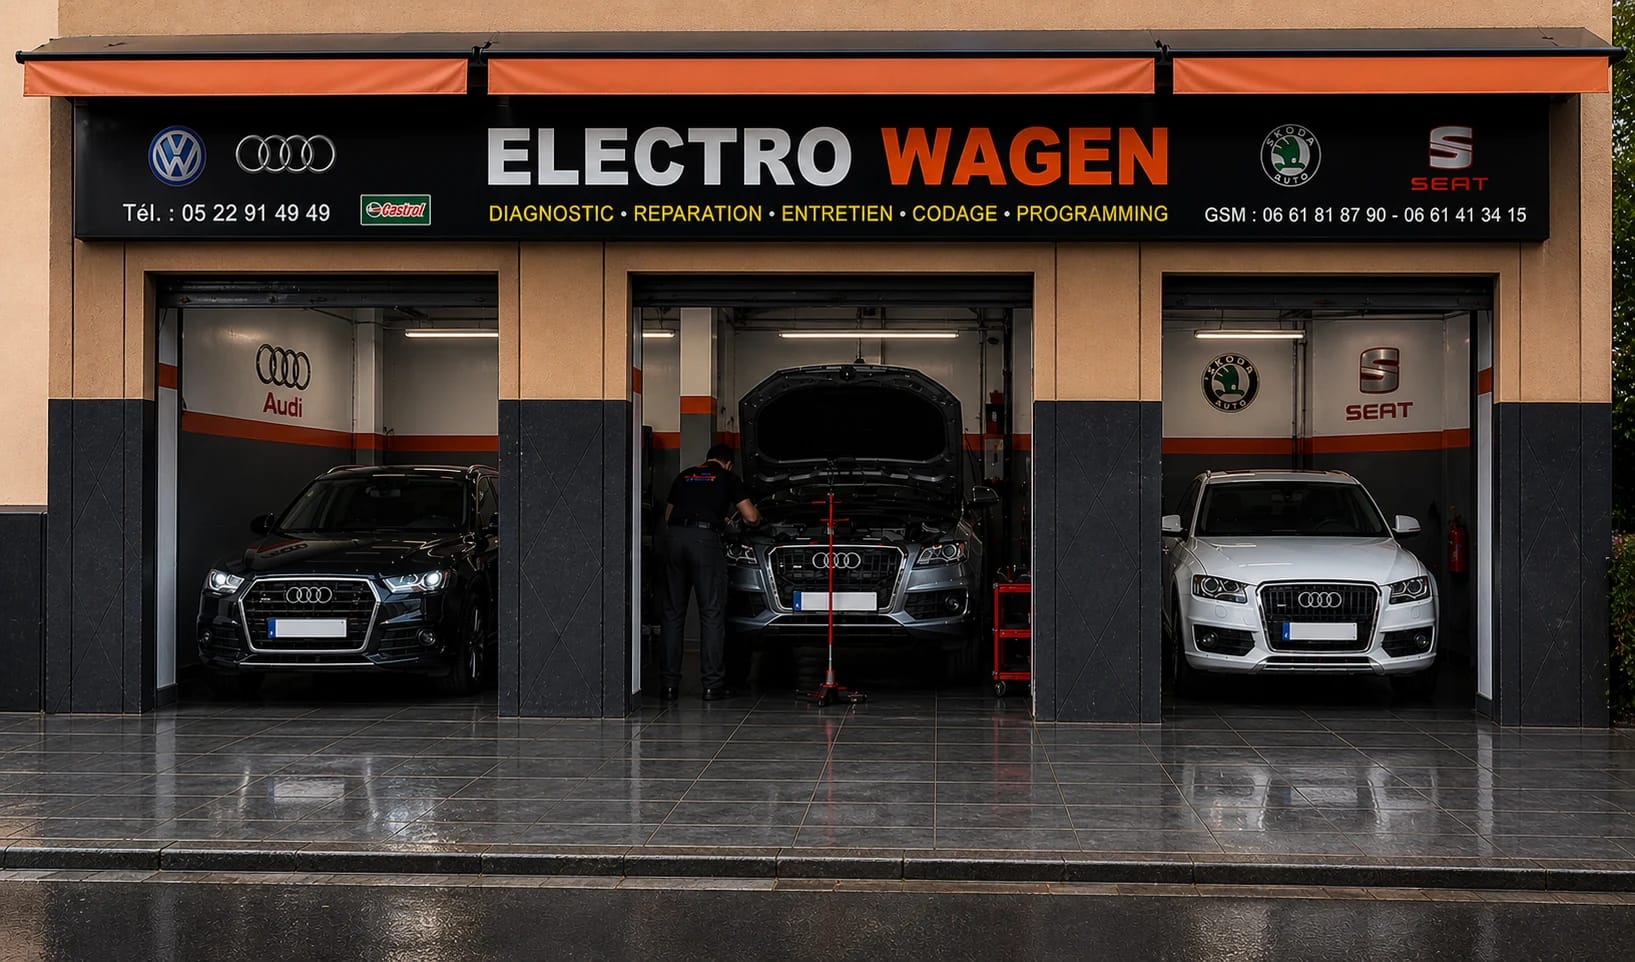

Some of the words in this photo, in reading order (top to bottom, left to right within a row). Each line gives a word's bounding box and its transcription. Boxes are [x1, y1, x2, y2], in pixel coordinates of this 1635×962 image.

[1266, 126, 1315, 148] SKODA
[488, 126, 852, 187] ELECTRO
[881, 127, 1169, 187] WAGEN
[1274, 173, 1308, 184] AUTO
[1411, 177, 1489, 191] SEAT
[123, 203, 161, 222] Tél.
[181, 203, 207, 222] 05
[212, 203, 238, 222] 22
[244, 203, 267, 222] 91
[274, 203, 299, 222] 49
[305, 203, 331, 222] 49
[382, 202, 427, 217] Castrol
[489, 205, 614, 222] DIAGNOSTIC
[634, 205, 762, 222] REPARATION
[782, 205, 893, 222] ENTRETIEN
[912, 205, 998, 222] CODAGE
[1017, 205, 1169, 222] PROGRAMMING
[1204, 206, 1246, 223] GSM
[1262, 206, 1284, 223] 06
[1288, 206, 1308, 223] 61
[1314, 206, 1333, 223] 81
[1340, 206, 1361, 223] 87
[1366, 206, 1387, 223] 90
[1404, 206, 1425, 223] 06
[1430, 206, 1449, 223] 61
[1455, 206, 1474, 223] 41
[1481, 206, 1502, 223] 34
[1507, 206, 1527, 223] 15
[262, 391, 303, 418] Audi
[1345, 401, 1414, 421] SEAT
